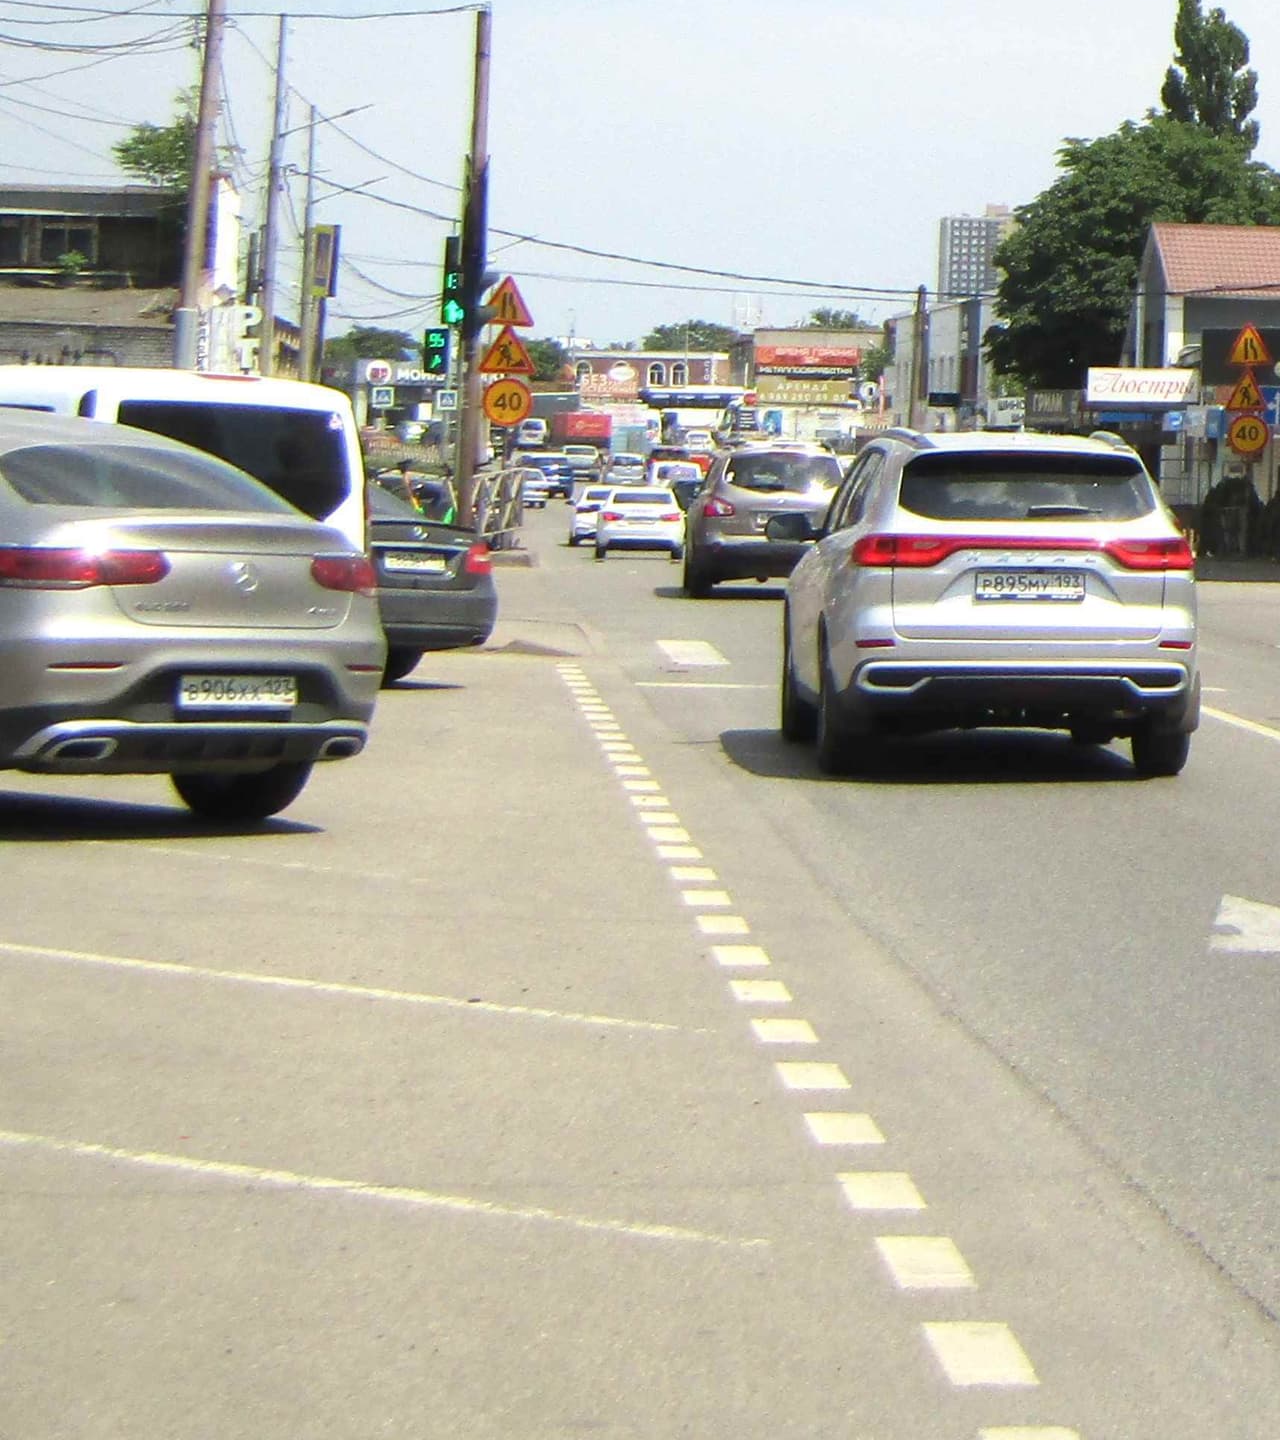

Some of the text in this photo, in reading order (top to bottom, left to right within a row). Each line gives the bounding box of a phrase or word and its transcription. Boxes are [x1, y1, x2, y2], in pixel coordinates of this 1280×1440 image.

[494, 392, 522, 410] 40
[1236, 425, 1259, 441] 40
[1055, 574, 1081, 588] 193
